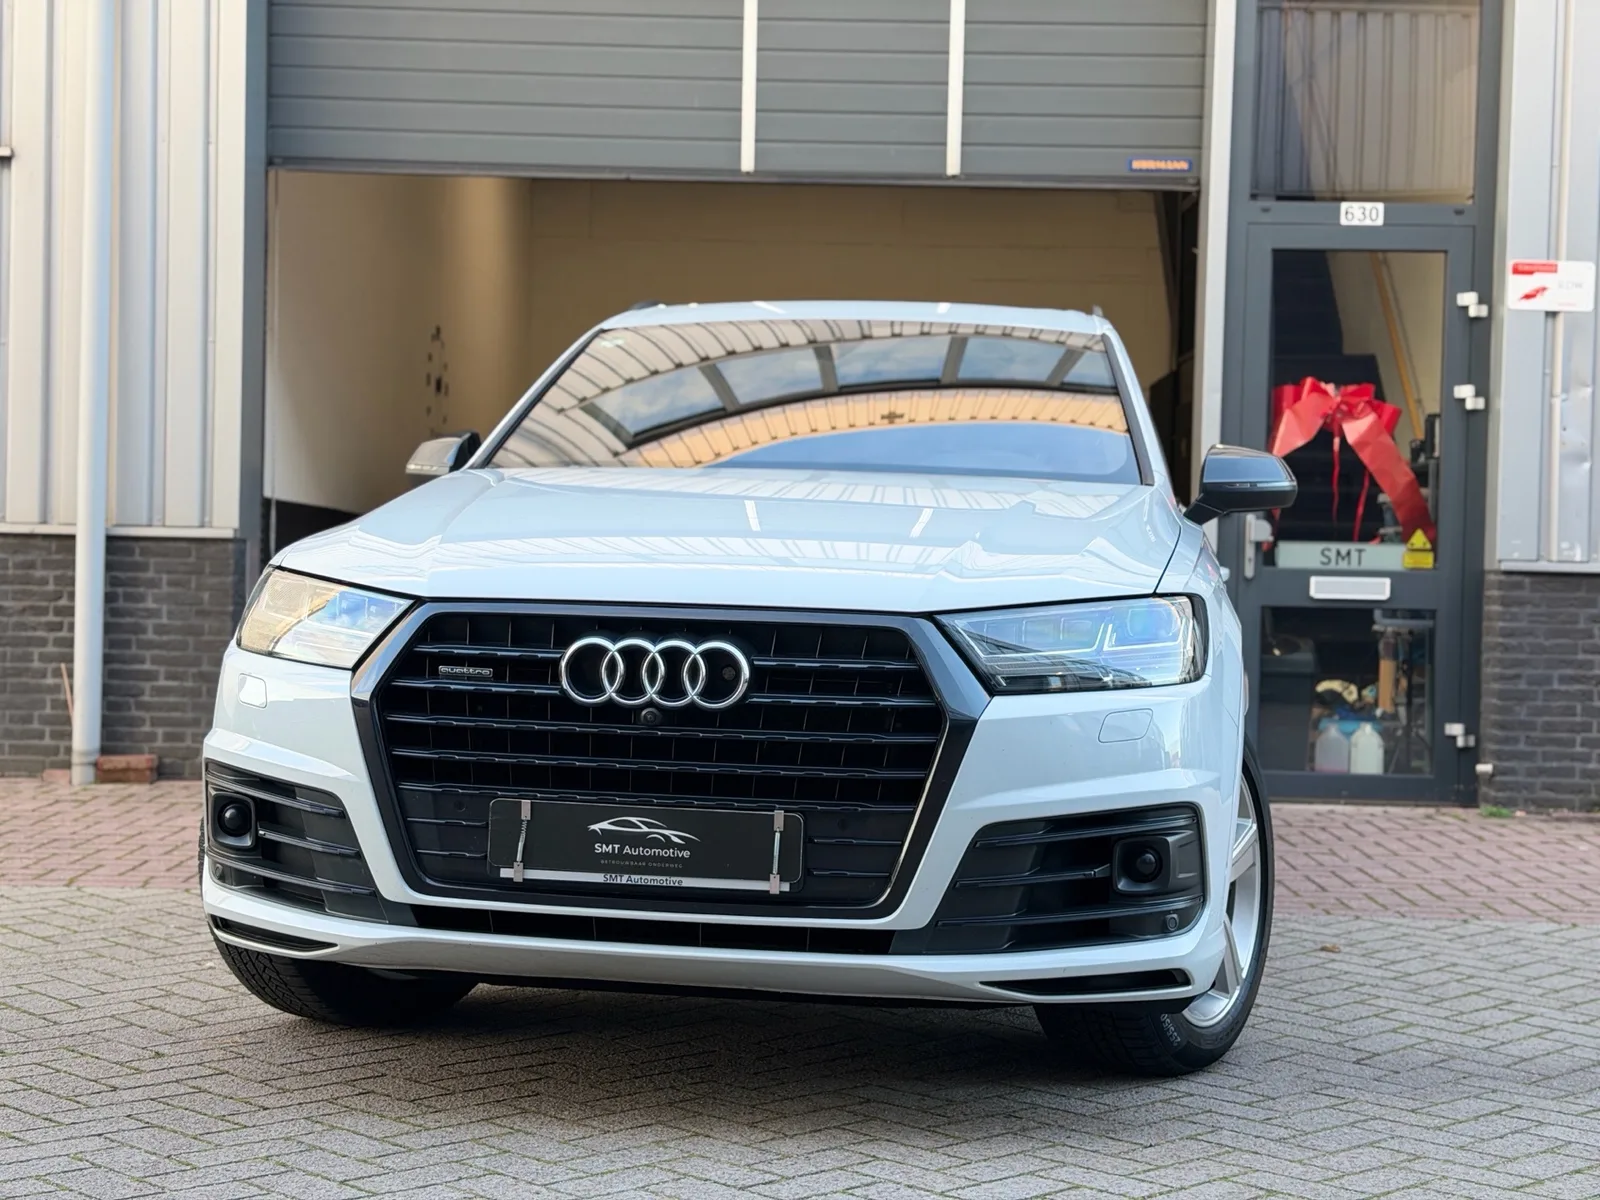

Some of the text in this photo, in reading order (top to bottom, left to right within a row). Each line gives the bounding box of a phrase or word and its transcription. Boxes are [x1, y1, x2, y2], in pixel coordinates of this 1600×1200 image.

[1345, 206, 1379, 221] 630
[1320, 547, 1366, 567] SMT
[440, 667, 490, 676] quattro
[594, 843, 691, 858] SMT Automotive
[603, 873, 683, 886] SMT Automotive
